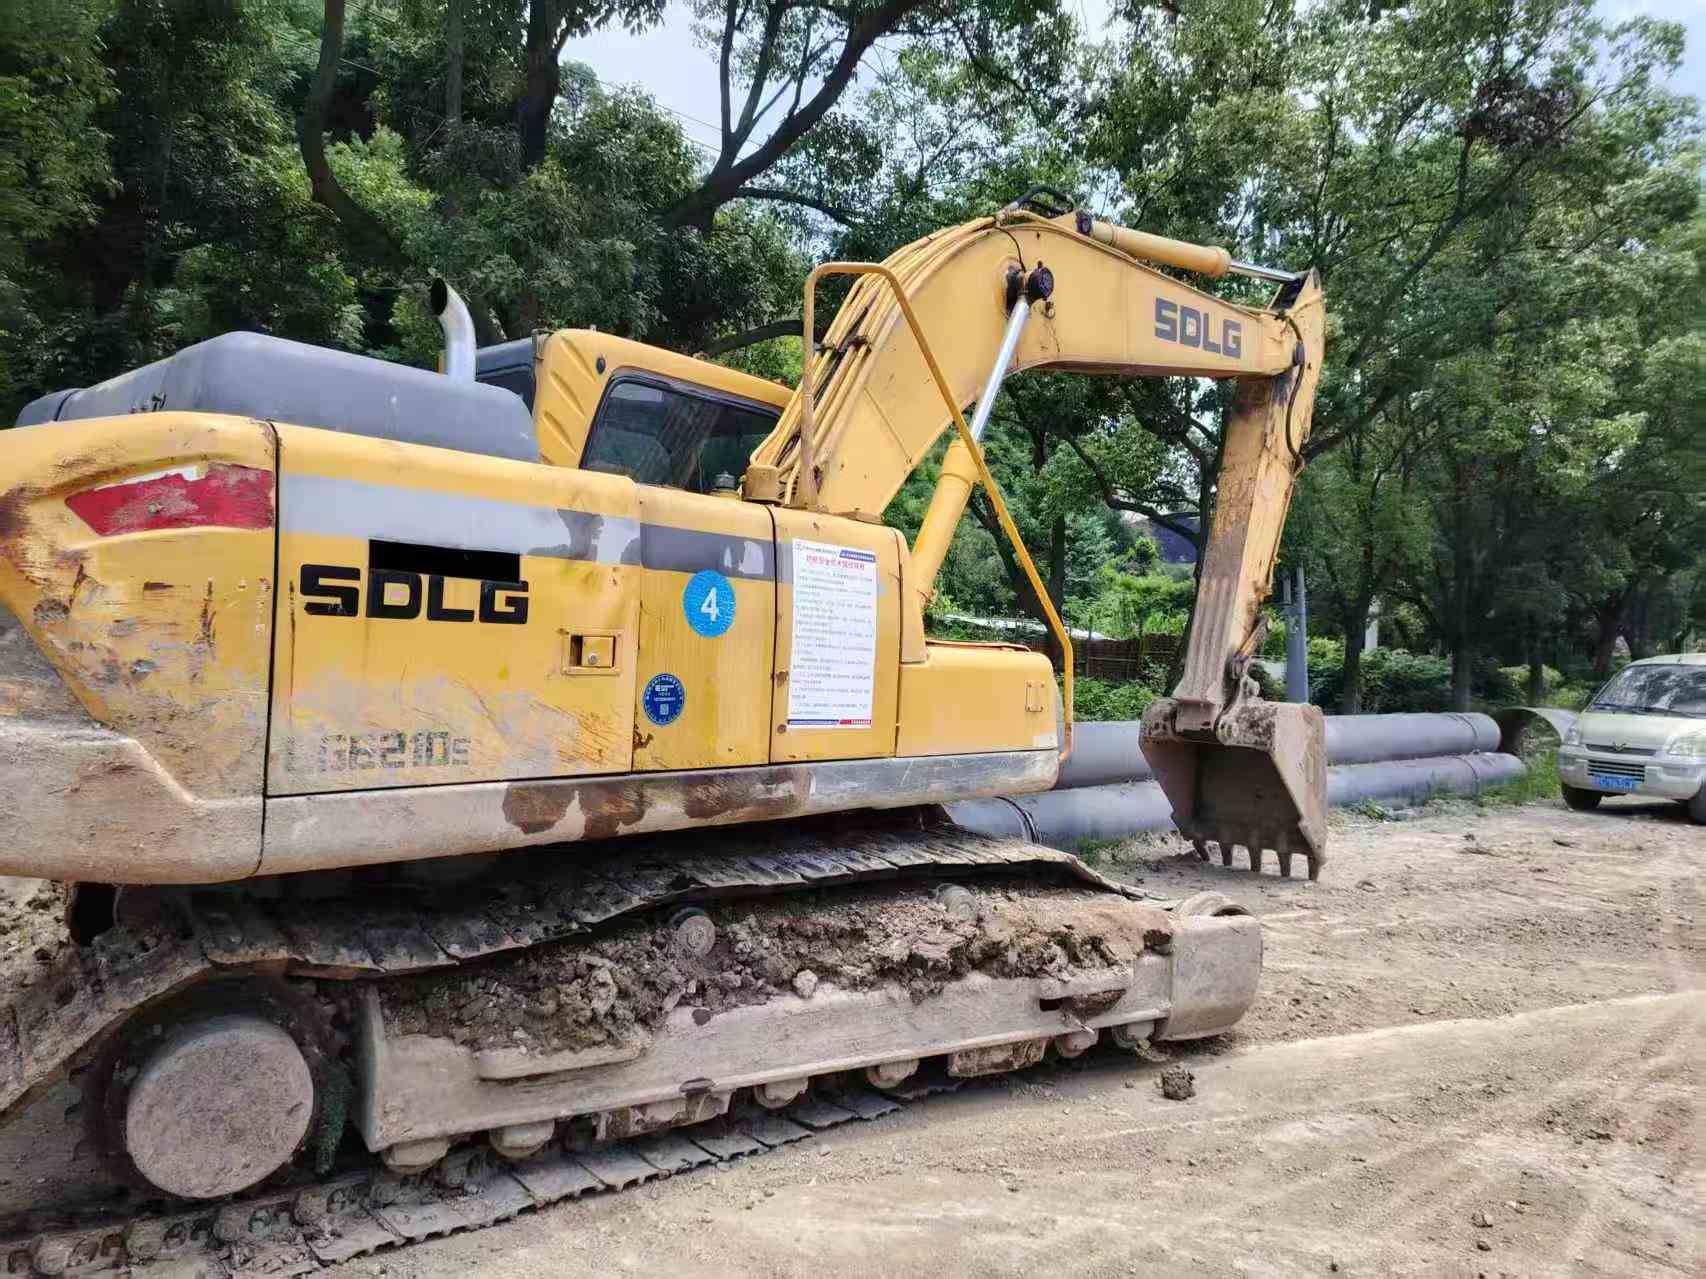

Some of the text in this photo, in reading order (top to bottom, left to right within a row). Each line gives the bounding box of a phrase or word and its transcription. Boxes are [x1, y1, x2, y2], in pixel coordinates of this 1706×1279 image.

[1155, 297, 1242, 359] SDLG
[300, 564, 529, 624] SDLG
[701, 586, 719, 622] 4
